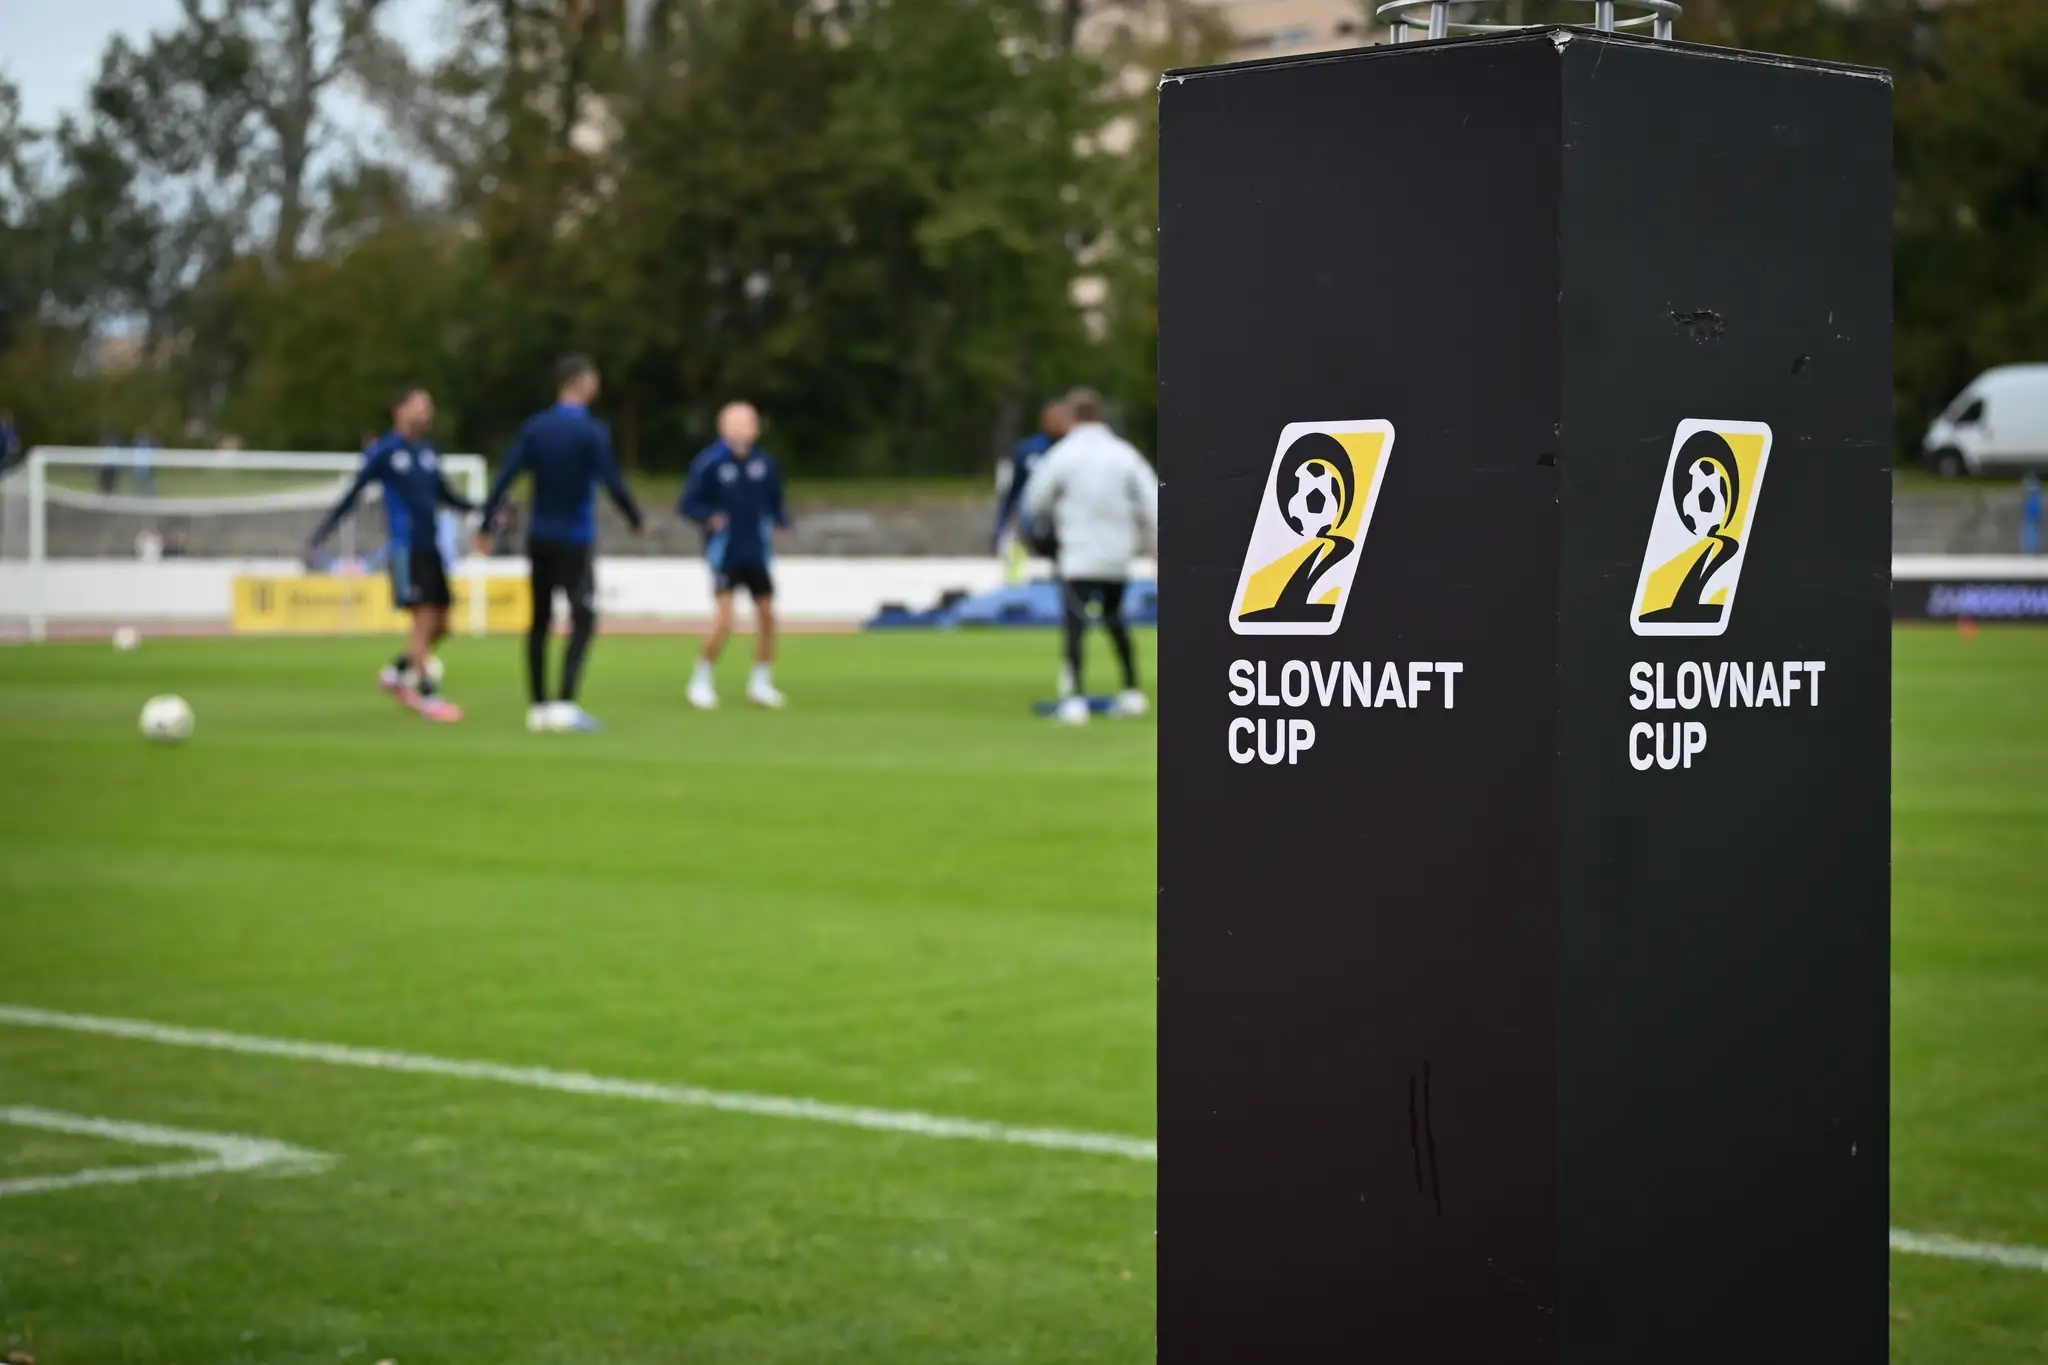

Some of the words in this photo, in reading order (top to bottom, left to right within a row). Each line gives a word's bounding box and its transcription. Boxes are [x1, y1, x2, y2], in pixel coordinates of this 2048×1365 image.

[1228, 659, 1464, 710] SLOVNAFT
[1628, 660, 1826, 711] SLOVNAFT
[1228, 716, 1316, 766] CUP
[1628, 721, 1707, 771] CUP
